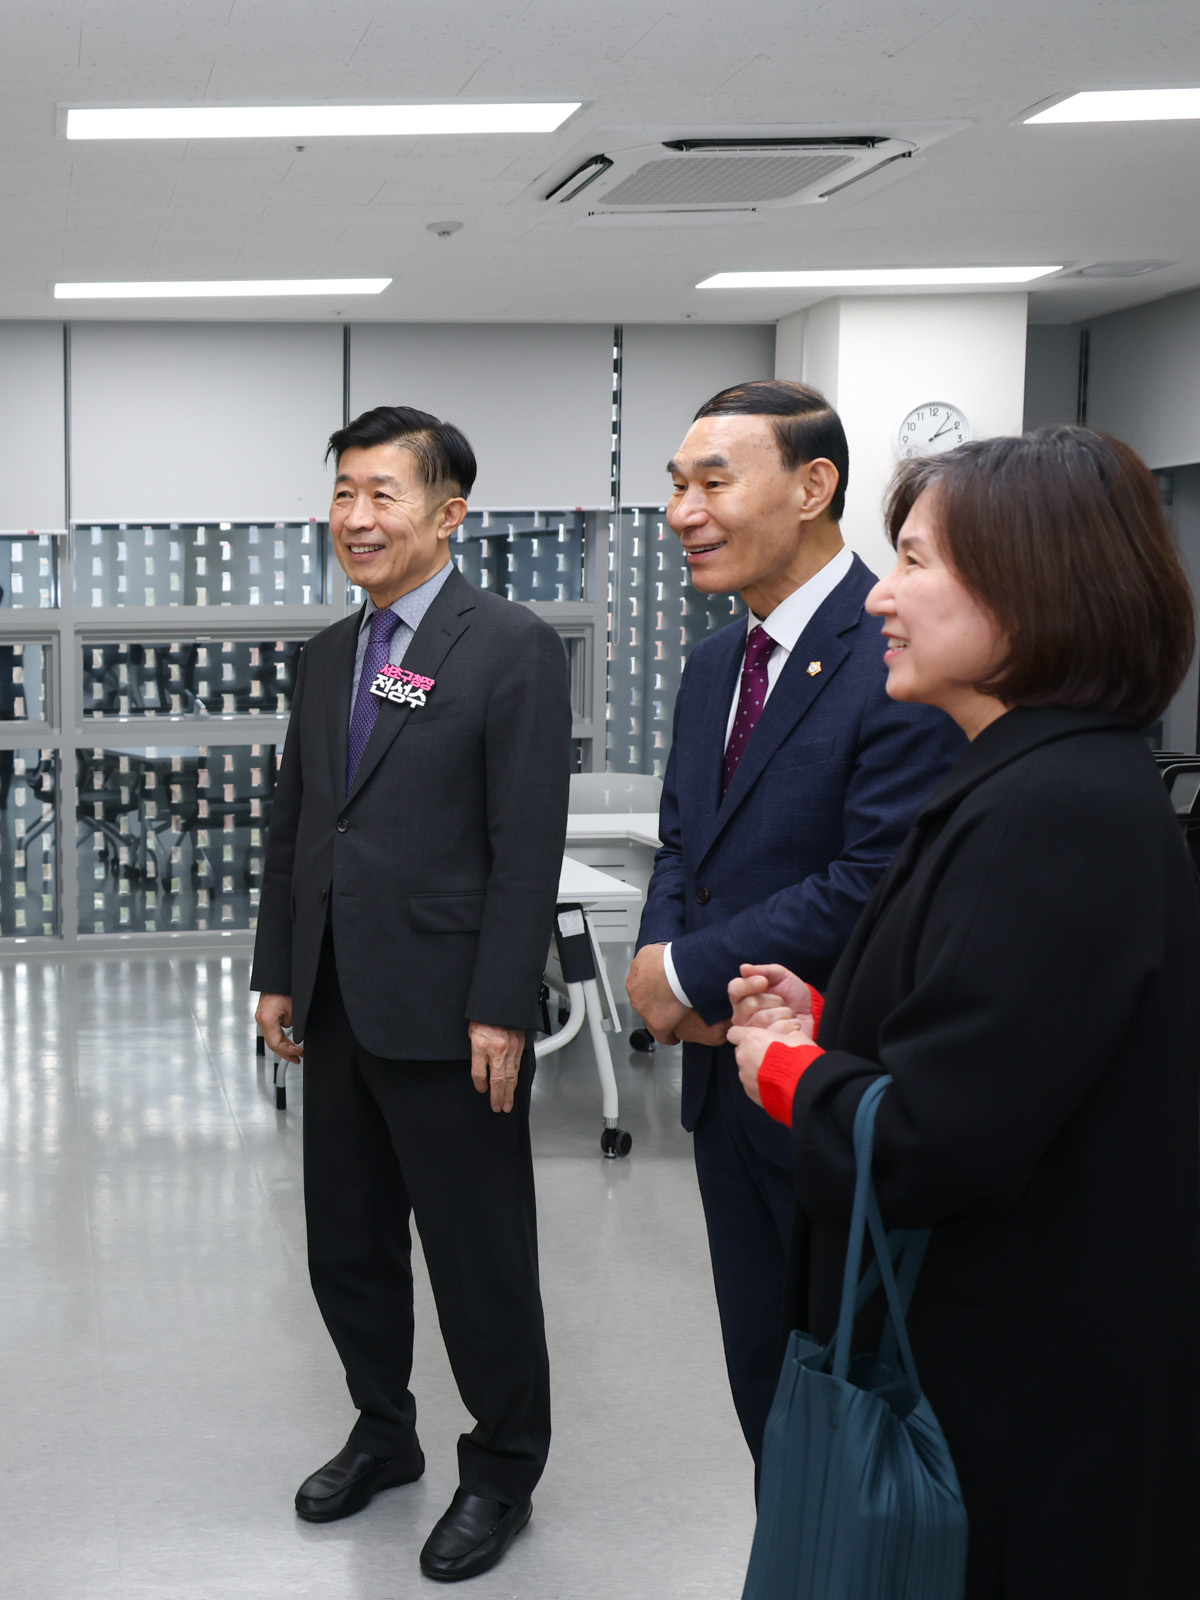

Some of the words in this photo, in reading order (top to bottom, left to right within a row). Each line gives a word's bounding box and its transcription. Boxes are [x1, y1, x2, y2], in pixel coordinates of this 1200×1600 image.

[917, 412, 924, 421] 11
[929, 407, 939, 417] 12
[907, 422, 916, 431] 10
[954, 421, 960, 430] 2
[903, 435, 909, 444] 9
[957, 434, 963, 443] 3
[906, 448, 912, 457] 8
[379, 663, 436, 691] 서초구청장
[369, 673, 427, 709] 전성수
